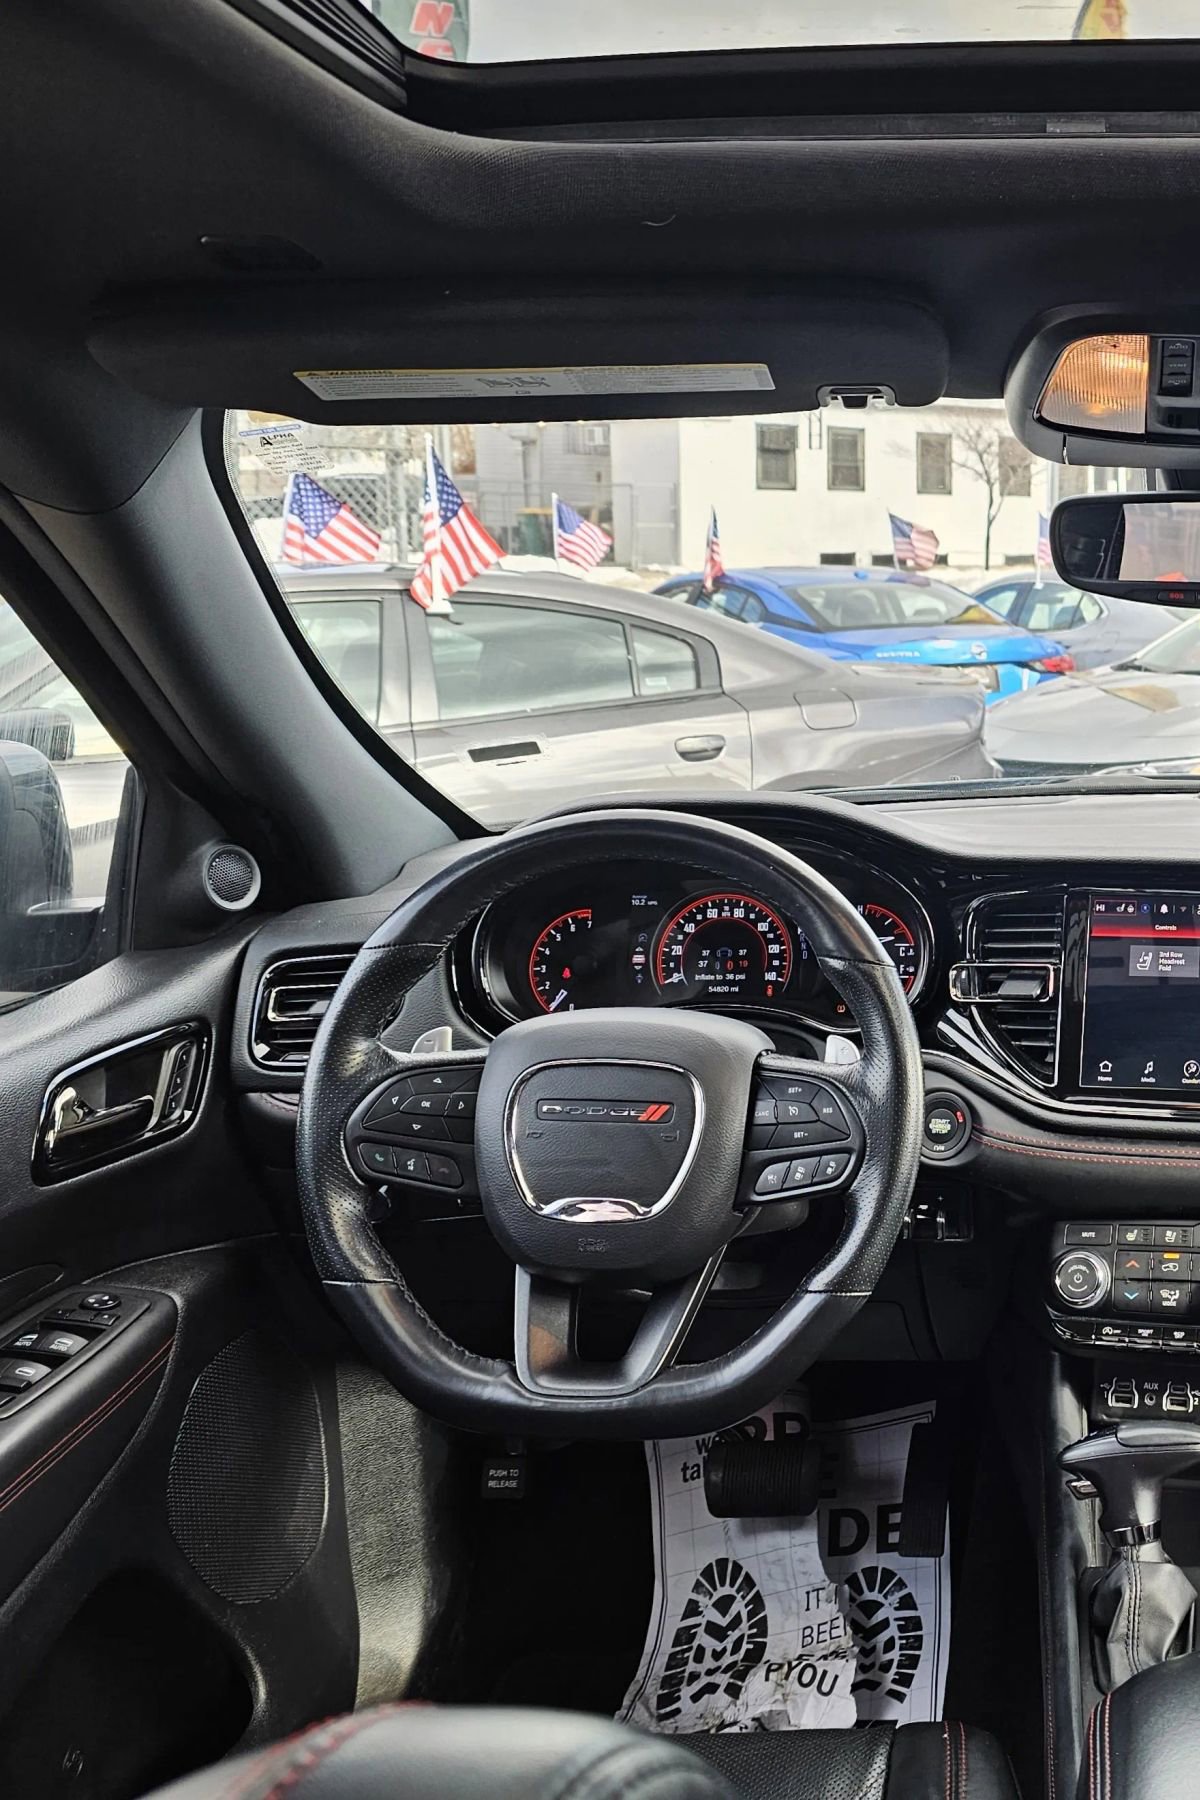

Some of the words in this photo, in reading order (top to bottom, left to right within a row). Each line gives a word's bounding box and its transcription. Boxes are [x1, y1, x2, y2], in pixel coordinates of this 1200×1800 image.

[260, 433, 295, 447] ALPHA
[707, 908, 718, 918] 60
[733, 908, 744, 918] 80
[683, 923, 695, 933] 40
[757, 922, 769, 931] 100
[672, 945, 682, 955] 20
[768, 944, 779, 953] 120
[698, 960, 709, 968] 37
[735, 973, 746, 981] psi
[765, 972, 776, 981] 140
[542, 1105, 645, 1116] DODGE
[823, 1106, 833, 1114] RES
[1144, 1382, 1159, 1391] AUX
[489, 1469, 508, 1477] PUSH
[488, 1480, 518, 1488] RELEASE
